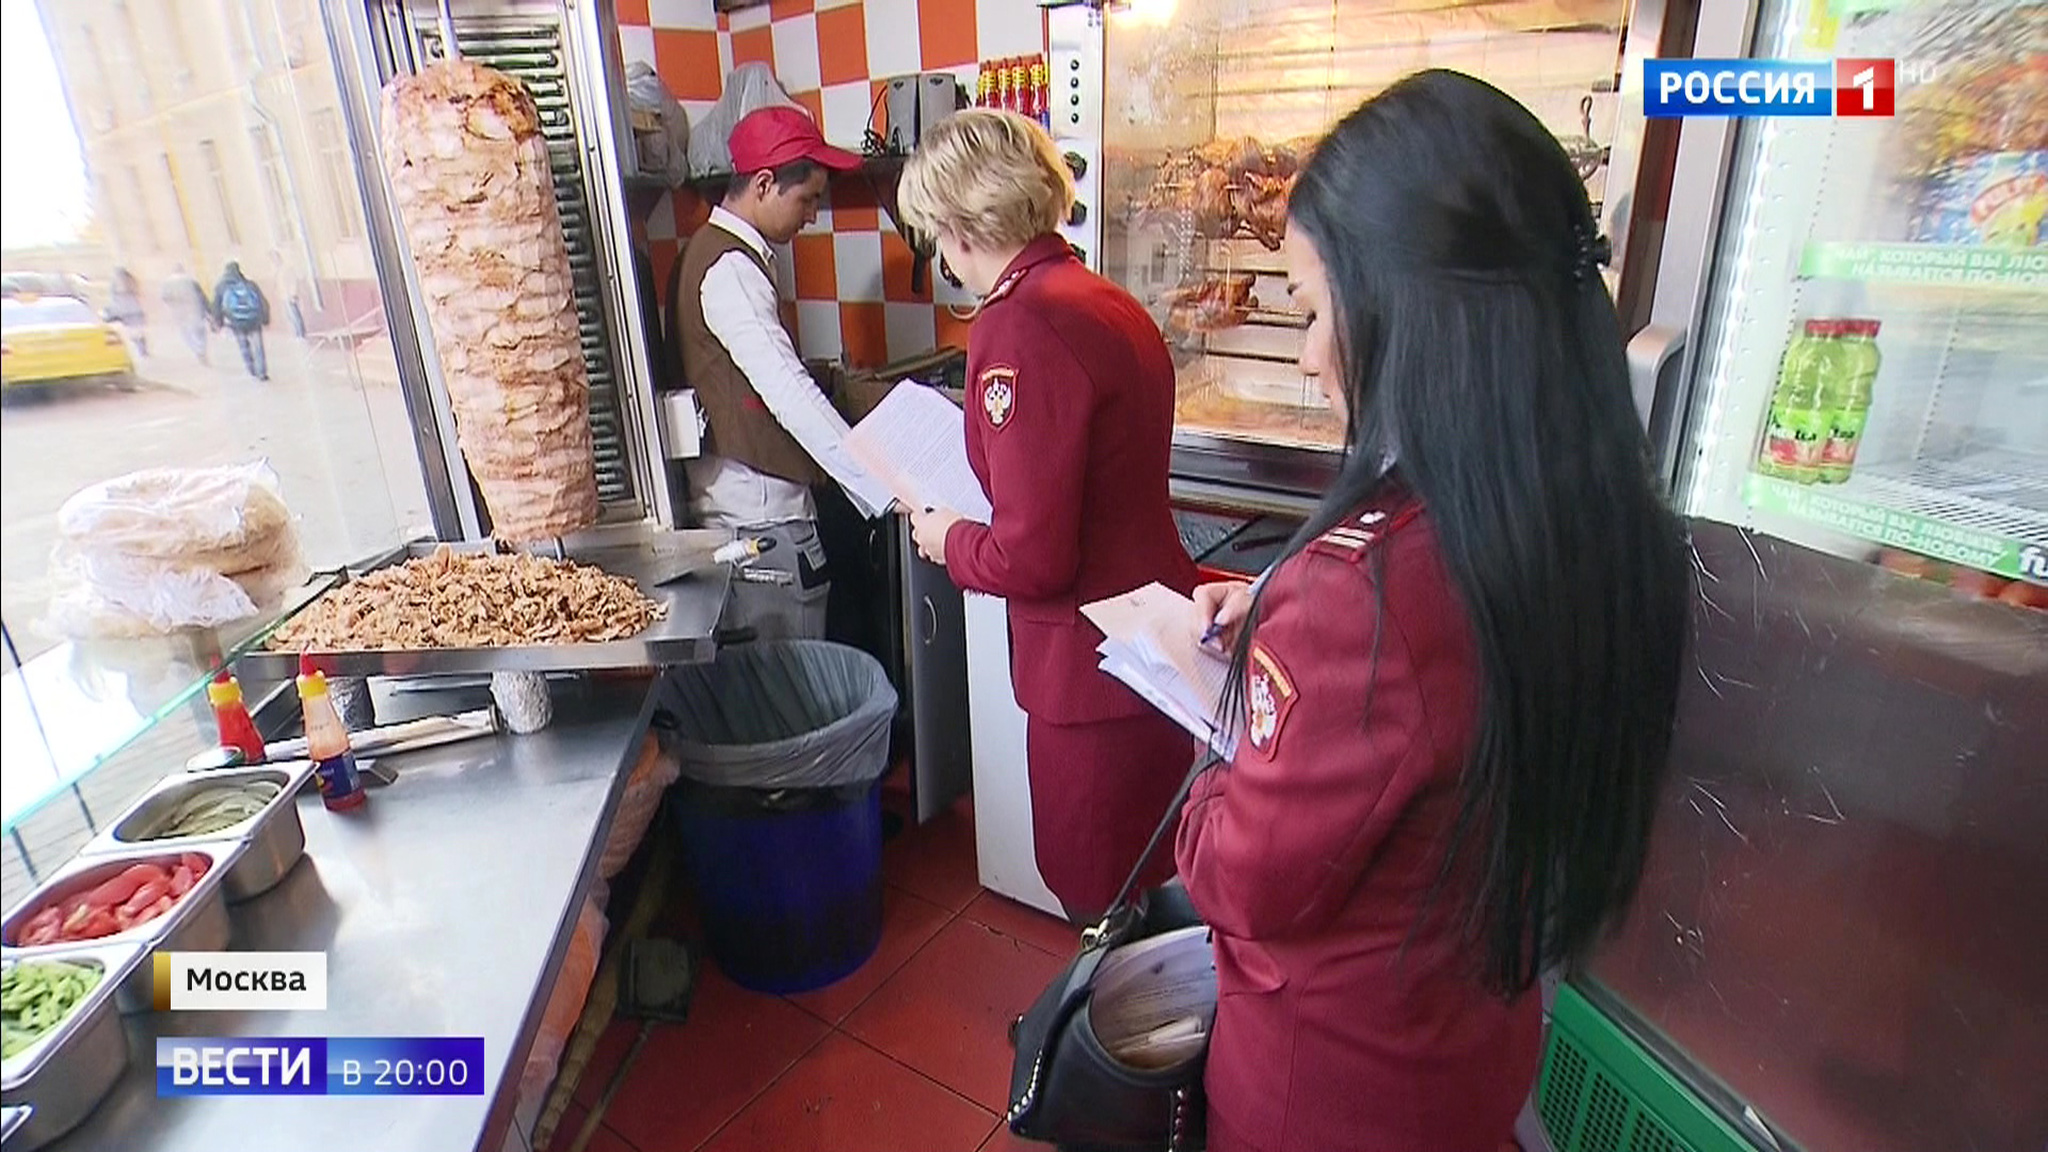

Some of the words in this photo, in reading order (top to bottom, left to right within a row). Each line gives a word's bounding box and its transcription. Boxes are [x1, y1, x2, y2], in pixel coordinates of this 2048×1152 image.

[1969, 252, 2002, 268] ВЫ
[1888, 513, 1916, 531] ВЫ
[1884, 528, 2003, 567] ПО-НОВОМУ
